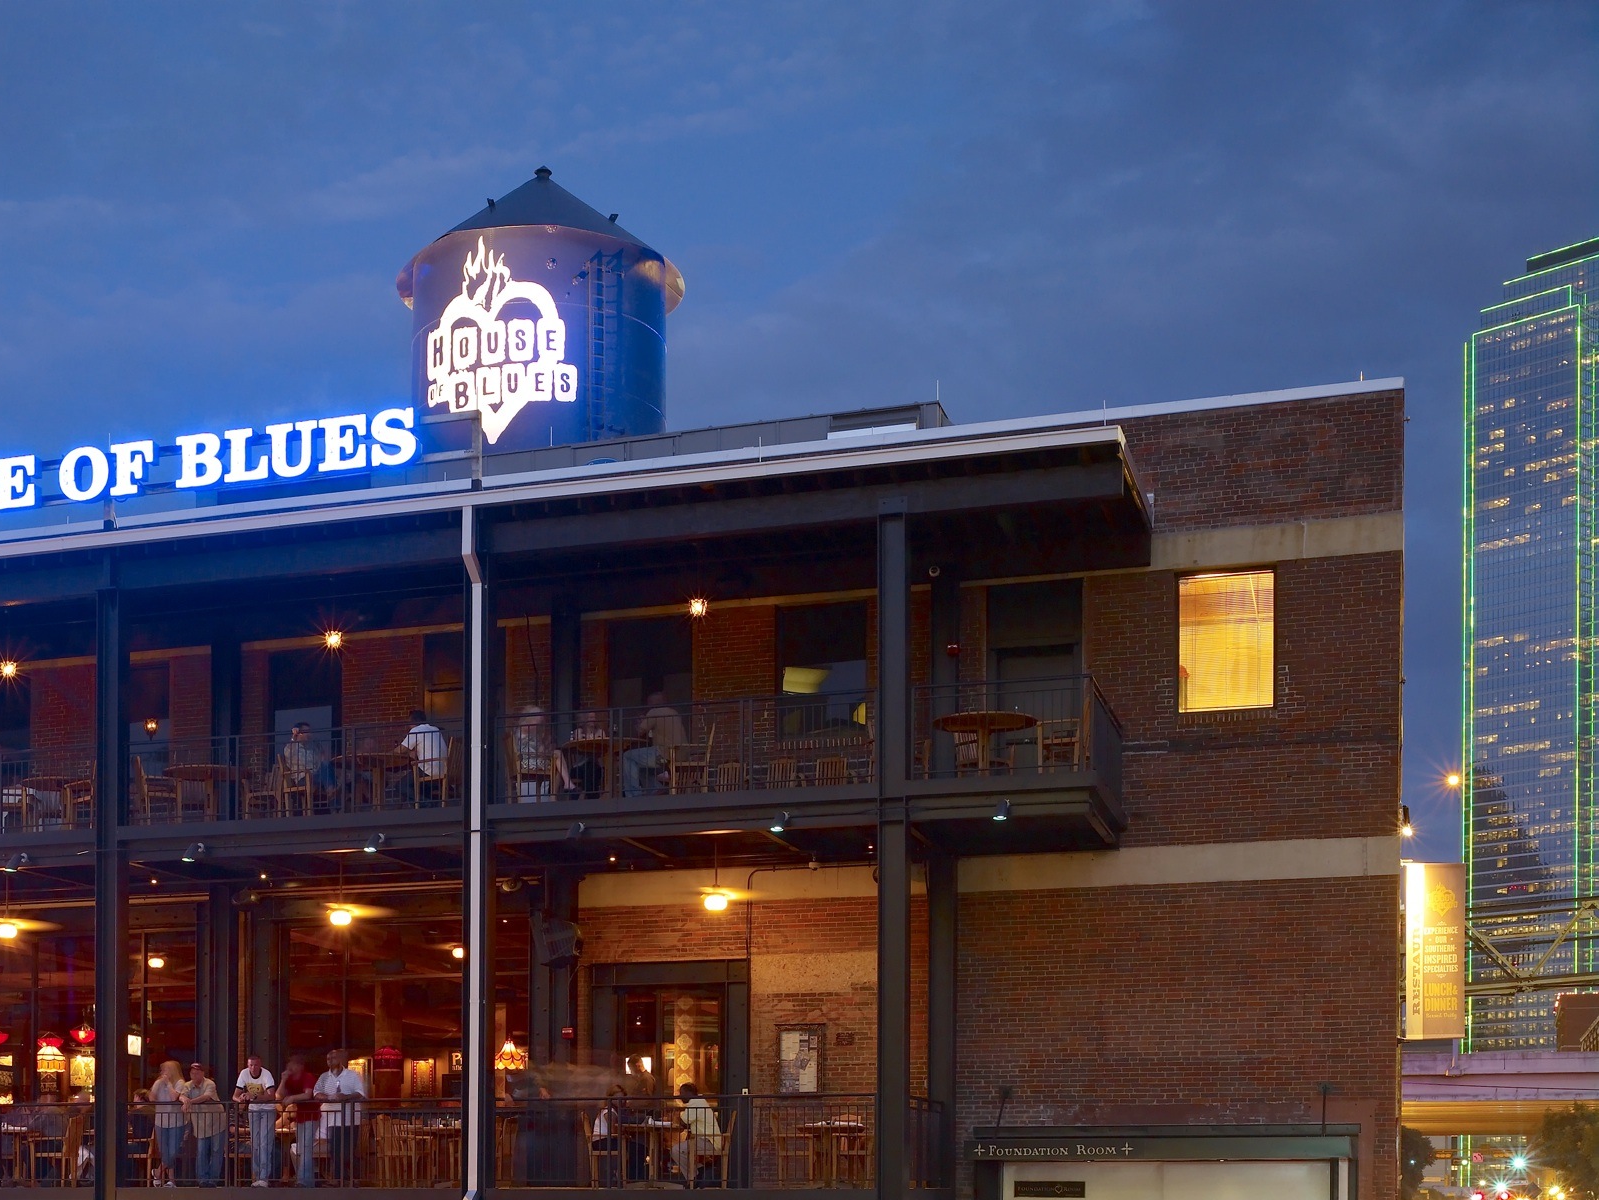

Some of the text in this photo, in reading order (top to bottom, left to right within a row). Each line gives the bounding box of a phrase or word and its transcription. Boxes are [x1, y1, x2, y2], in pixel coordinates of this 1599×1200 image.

[432, 330, 557, 363] HOUSE
[430, 372, 570, 409] OF BLUES
[58, 440, 155, 502] OF
[175, 406, 417, 490] BLUES
[1424, 954, 1458, 964] INSPIRED
[1424, 965, 1459, 973] SPECIALTIES
[1424, 997, 1458, 1011] DINNER
